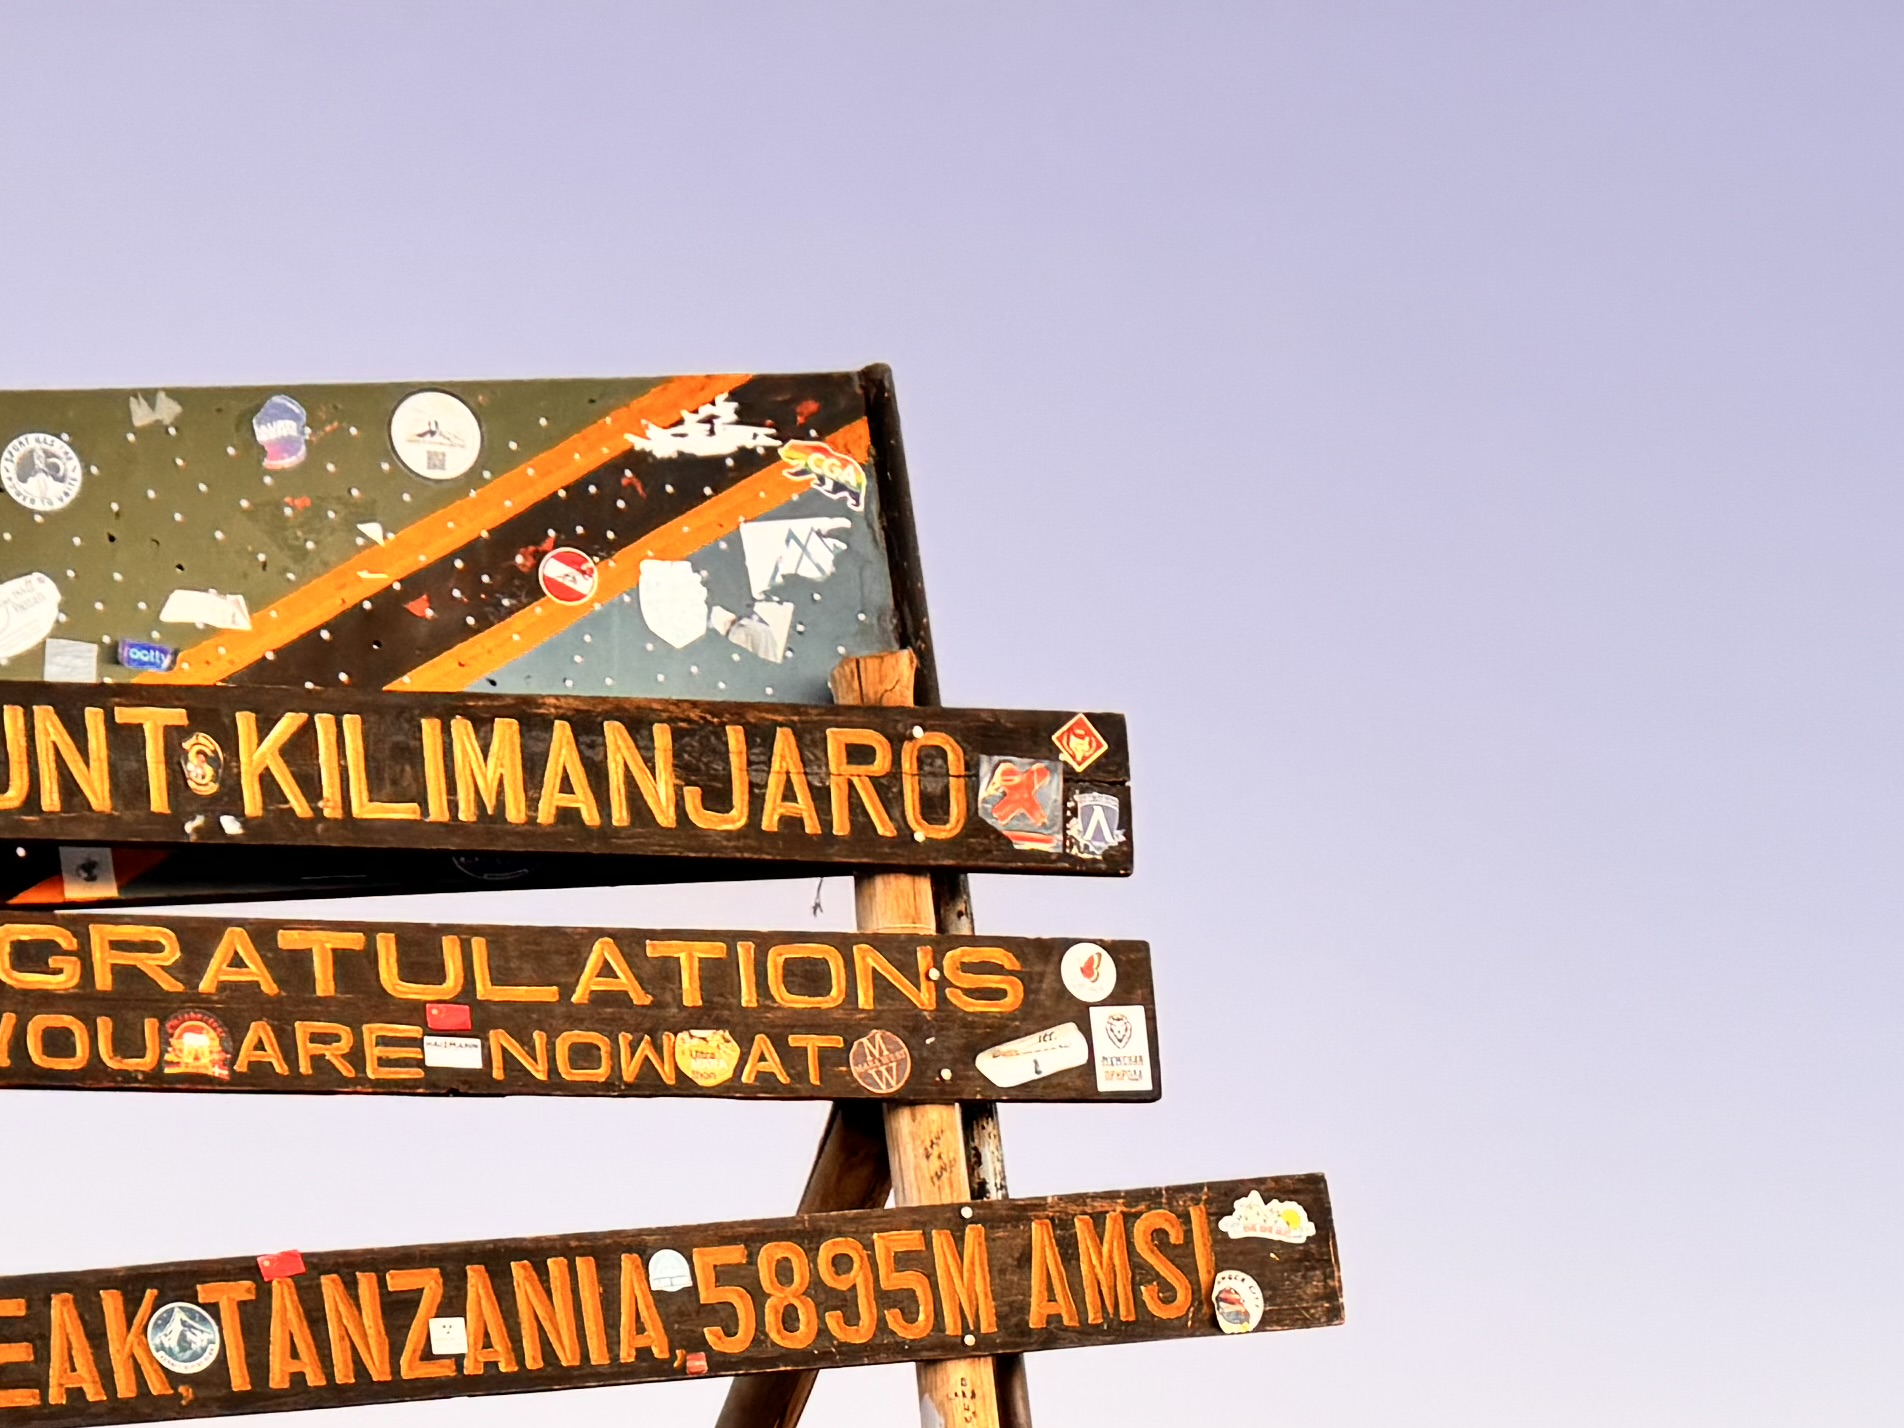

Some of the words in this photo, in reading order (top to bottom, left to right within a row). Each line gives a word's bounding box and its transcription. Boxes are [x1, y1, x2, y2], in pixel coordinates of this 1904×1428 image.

[806, 452, 858, 488] CGA
[234, 711, 967, 840] KILIMANJARO
[233, 1020, 426, 1080] ARE
[487, 1028, 676, 1087] NOW
[741, 1033, 846, 1087] AT
[691, 1223, 998, 1354] 5895M
